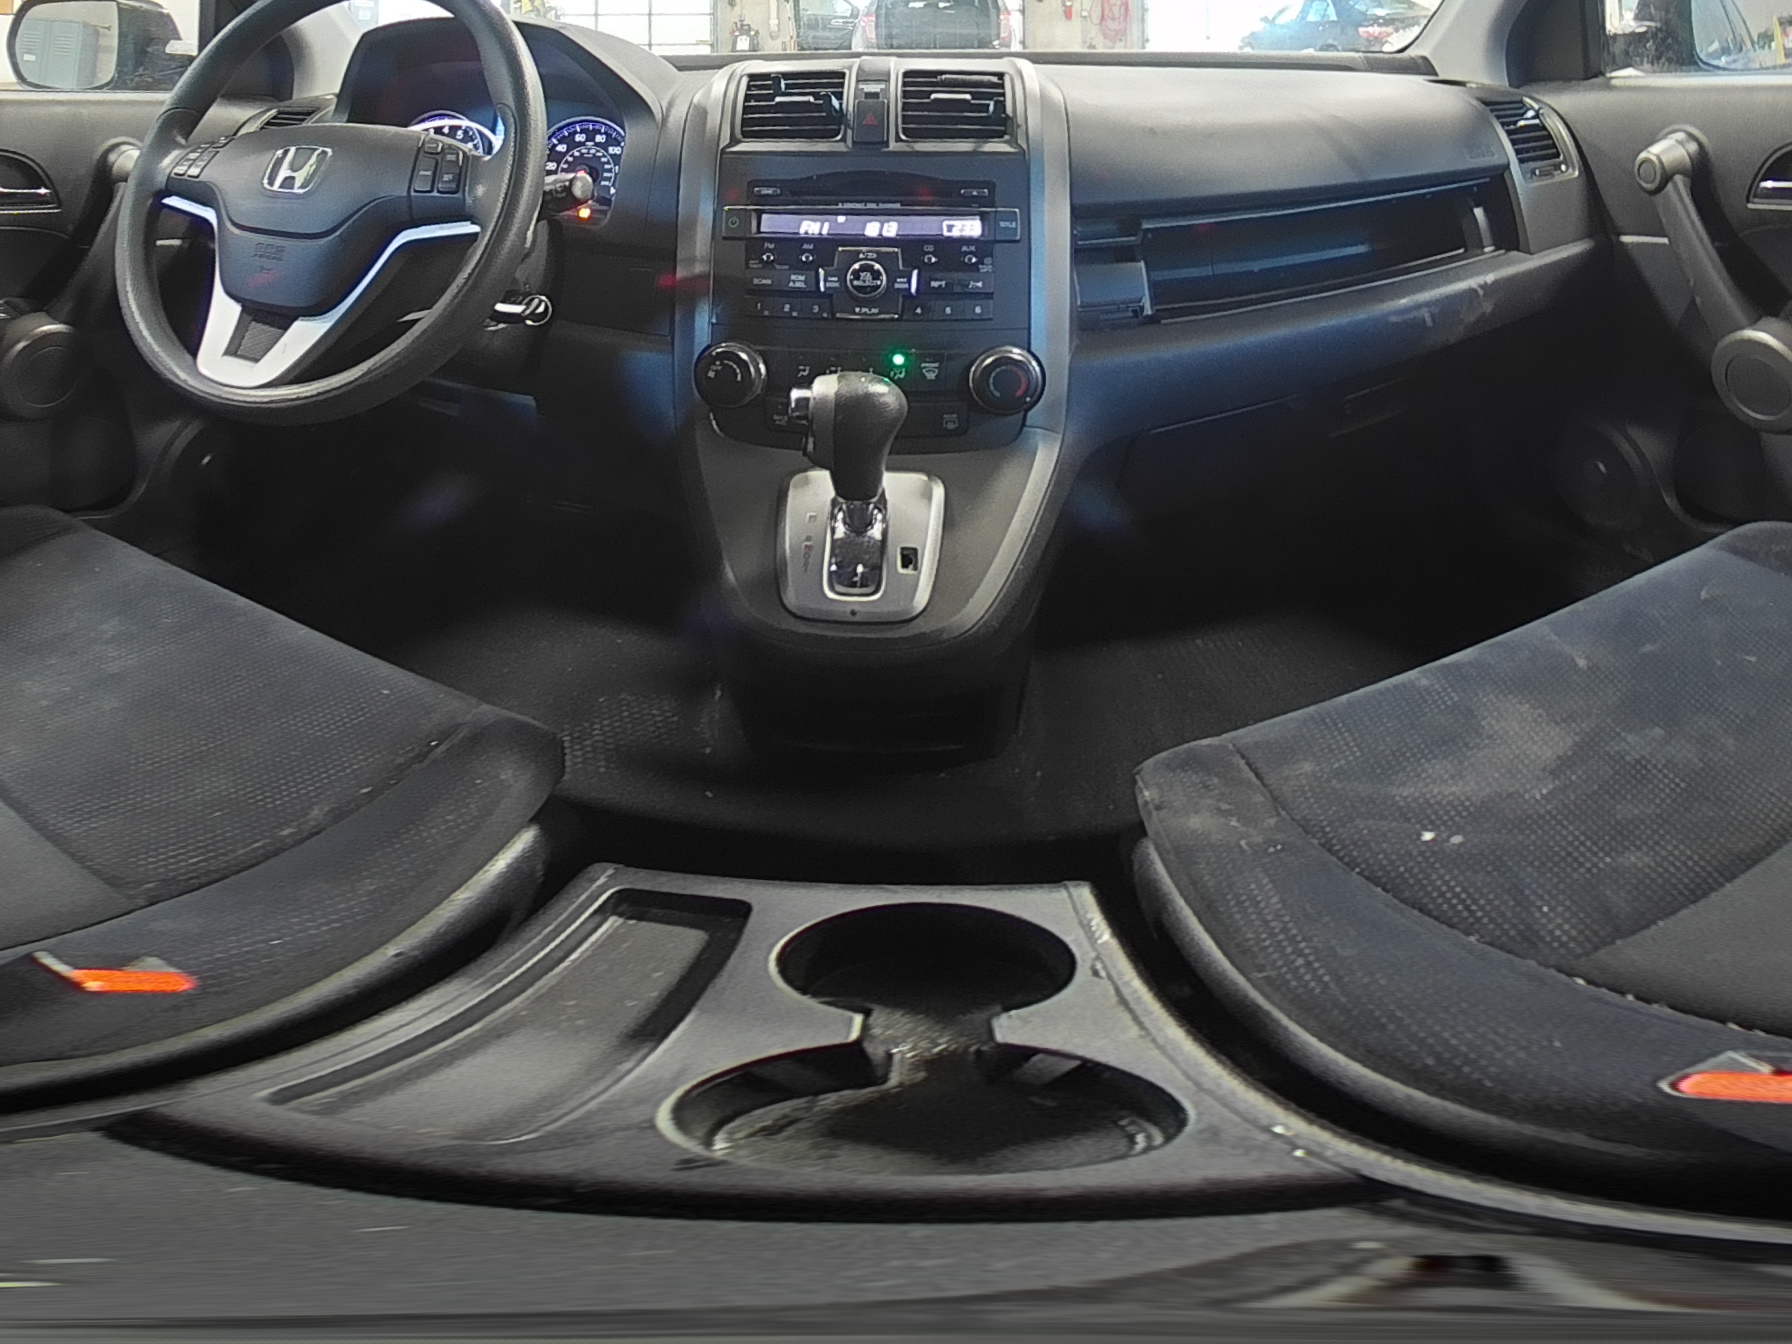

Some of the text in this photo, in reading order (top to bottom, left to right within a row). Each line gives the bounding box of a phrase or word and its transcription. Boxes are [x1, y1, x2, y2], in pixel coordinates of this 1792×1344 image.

[456, 130, 463, 139] 5
[595, 134, 607, 143] 80
[555, 144, 567, 152] 40
[545, 162, 557, 170] 20
[914, 306, 922, 314] 4
